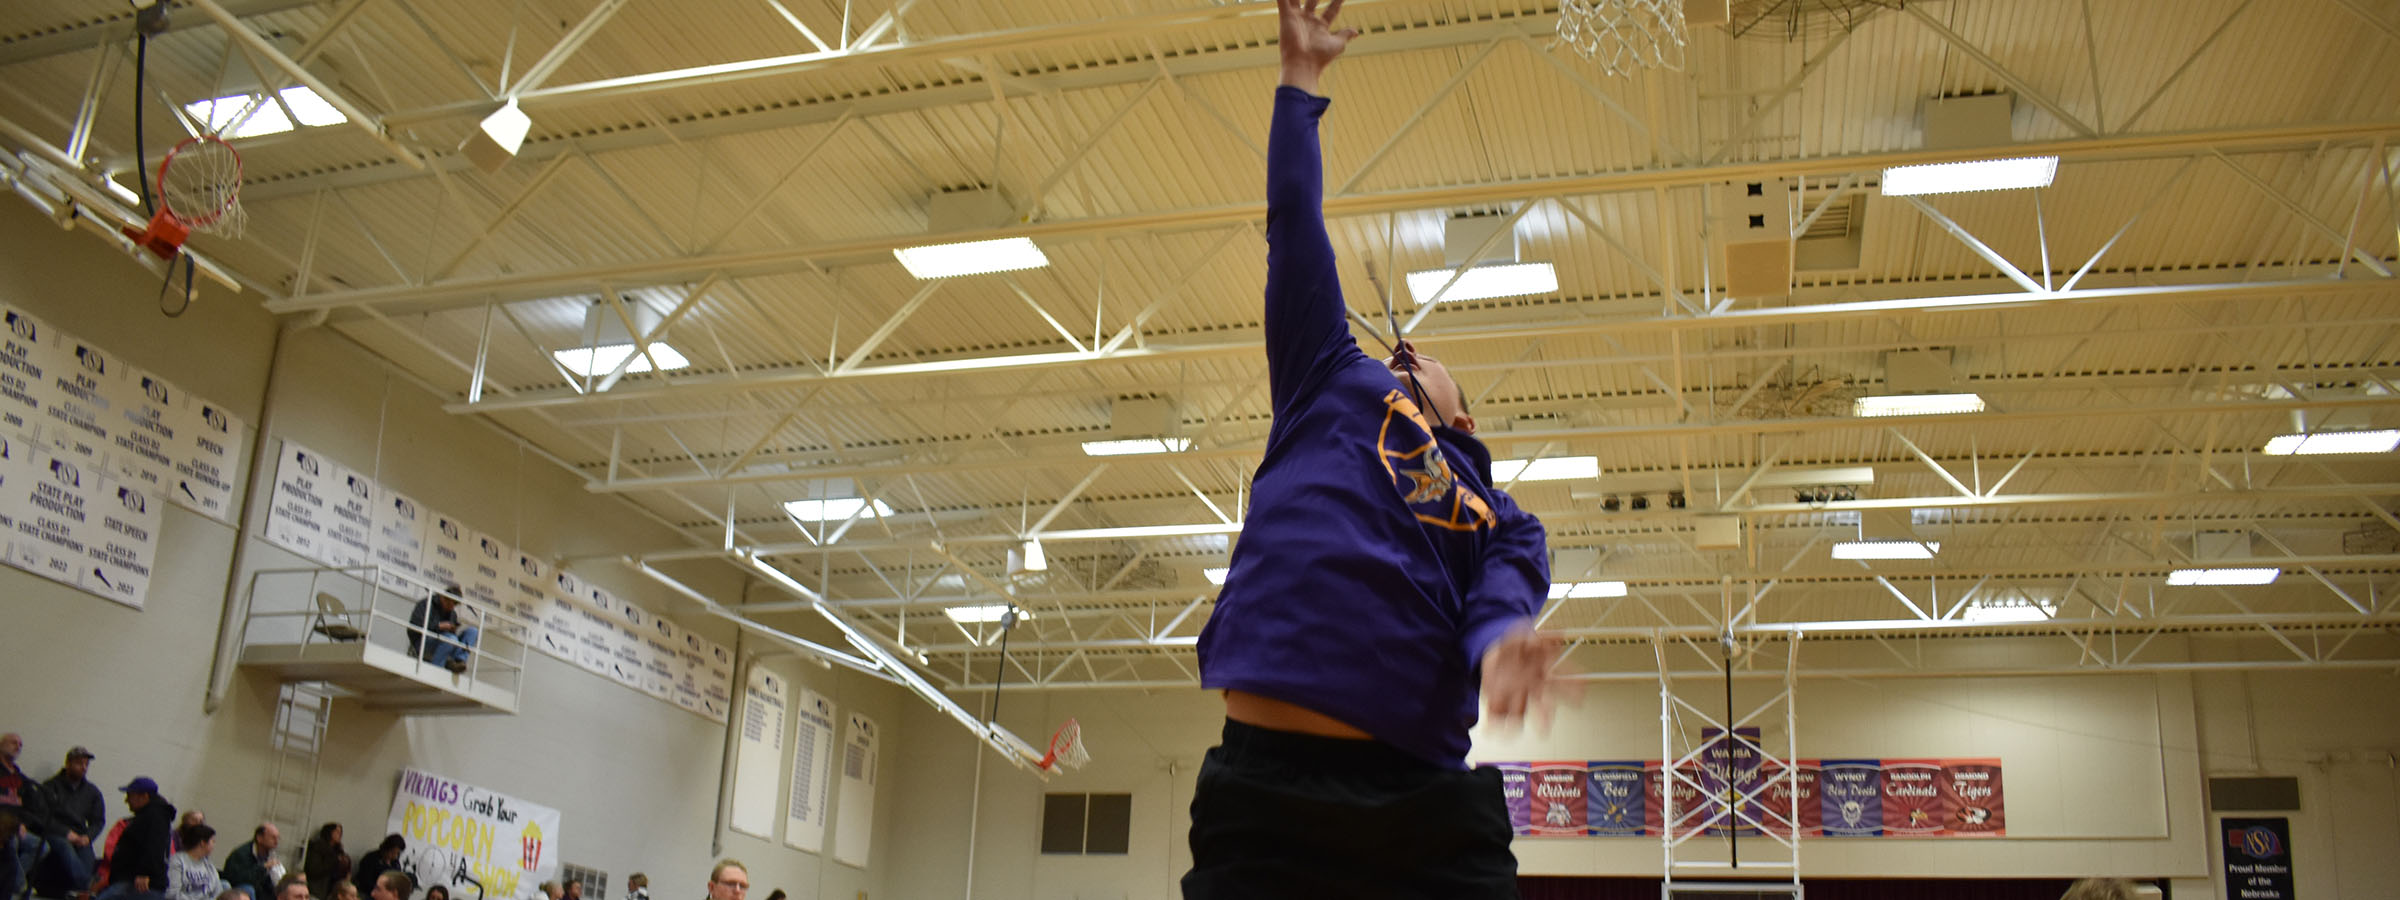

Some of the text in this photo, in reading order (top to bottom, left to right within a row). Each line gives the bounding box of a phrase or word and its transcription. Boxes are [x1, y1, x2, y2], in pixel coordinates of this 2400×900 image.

[6, 340, 28, 358] PLAY
[77, 372, 97, 391] PLAY
[116, 436, 134, 452] STATE
[130, 431, 150, 448] CLASS
[197, 436, 224, 456] SPEECH
[176, 462, 194, 478] STATE
[192, 458, 210, 472] CLASS
[297, 476, 312, 490] PLAY
[38, 480, 84, 508] STATE PLAY
[282, 480, 322, 508] PRODUCTION
[30, 491, 86, 524] PRODUCTION
[348, 500, 362, 512] PLAY
[38, 516, 60, 532] CLASS
[104, 516, 148, 543] STATE SPEECH
[18, 520, 84, 553] STATE CHAMPIONS
[106, 542, 126, 556] CLASS
[438, 544, 457, 561] SPEECH
[89, 547, 149, 578] STATE CHAMPIONS
[478, 564, 496, 580] SPEECH
[1834, 772, 1867, 782] WYNOT
[1890, 772, 1932, 782] RANDOLPH
[1954, 772, 1990, 781] OSMOND
[404, 770, 518, 824] VIKINGS Grab Your
[1537, 783, 1581, 798] Wildcats
[1602, 781, 1628, 798] Bees
[1653, 783, 1696, 801] Bldogs
[1886, 782, 1937, 797] Cardinals
[1953, 781, 1992, 800] Tigers
[402, 800, 495, 864] POPCORN
[2229, 864, 2286, 874] Proud Member
[2248, 876, 2272, 886] of the
[2240, 888, 2280, 898] Nebraska
